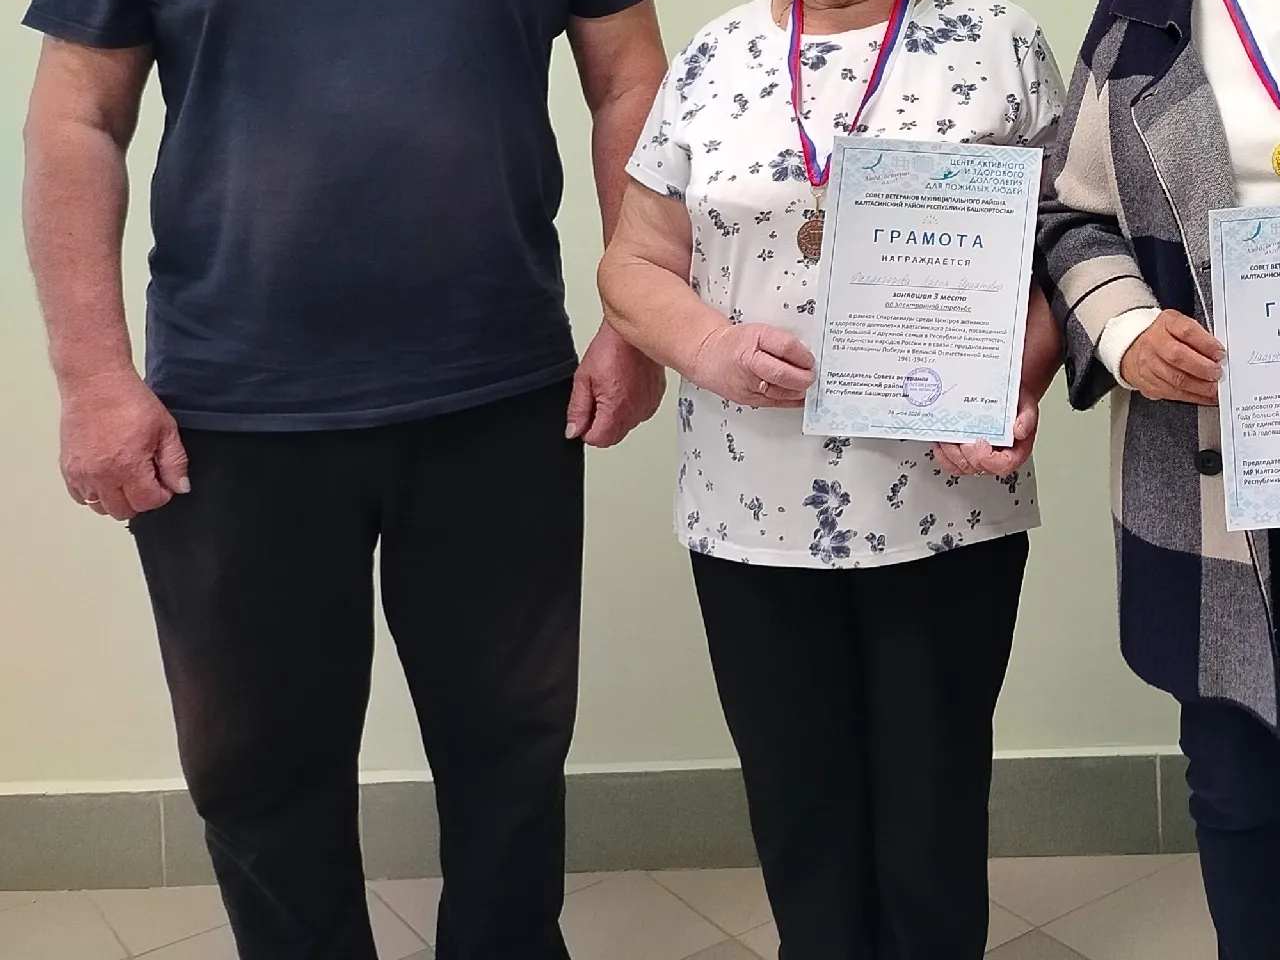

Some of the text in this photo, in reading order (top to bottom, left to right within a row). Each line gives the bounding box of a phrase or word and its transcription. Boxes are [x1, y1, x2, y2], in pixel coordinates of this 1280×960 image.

[949, 158, 1025, 170] ЦЕНТР АКТИВНОГО
[972, 168, 1024, 179] ЗДОРОВОГО
[968, 176, 1023, 187] ДОЛГОЛЕТИЯ
[924, 181, 1022, 195] ДЛЯ ПОЖИЛЫХ ЛЮДЕЙ
[920, 195, 980, 205] МУНИЦИПАЛЬНОГО
[980, 198, 1006, 206] РАЙОНА
[904, 201, 925, 209] РАЙОН
[925, 203, 965, 211] РЕСПУБЛИКИ
[966, 206, 1014, 215] БАШКОРТОСТАН
[873, 228, 984, 249] ГРАМОТА
[881, 254, 971, 267] НАГРАЖДАЕТСЯ
[1249, 263, 1269, 271] СОВЕТ
[826, 370, 872, 379] Председатель
